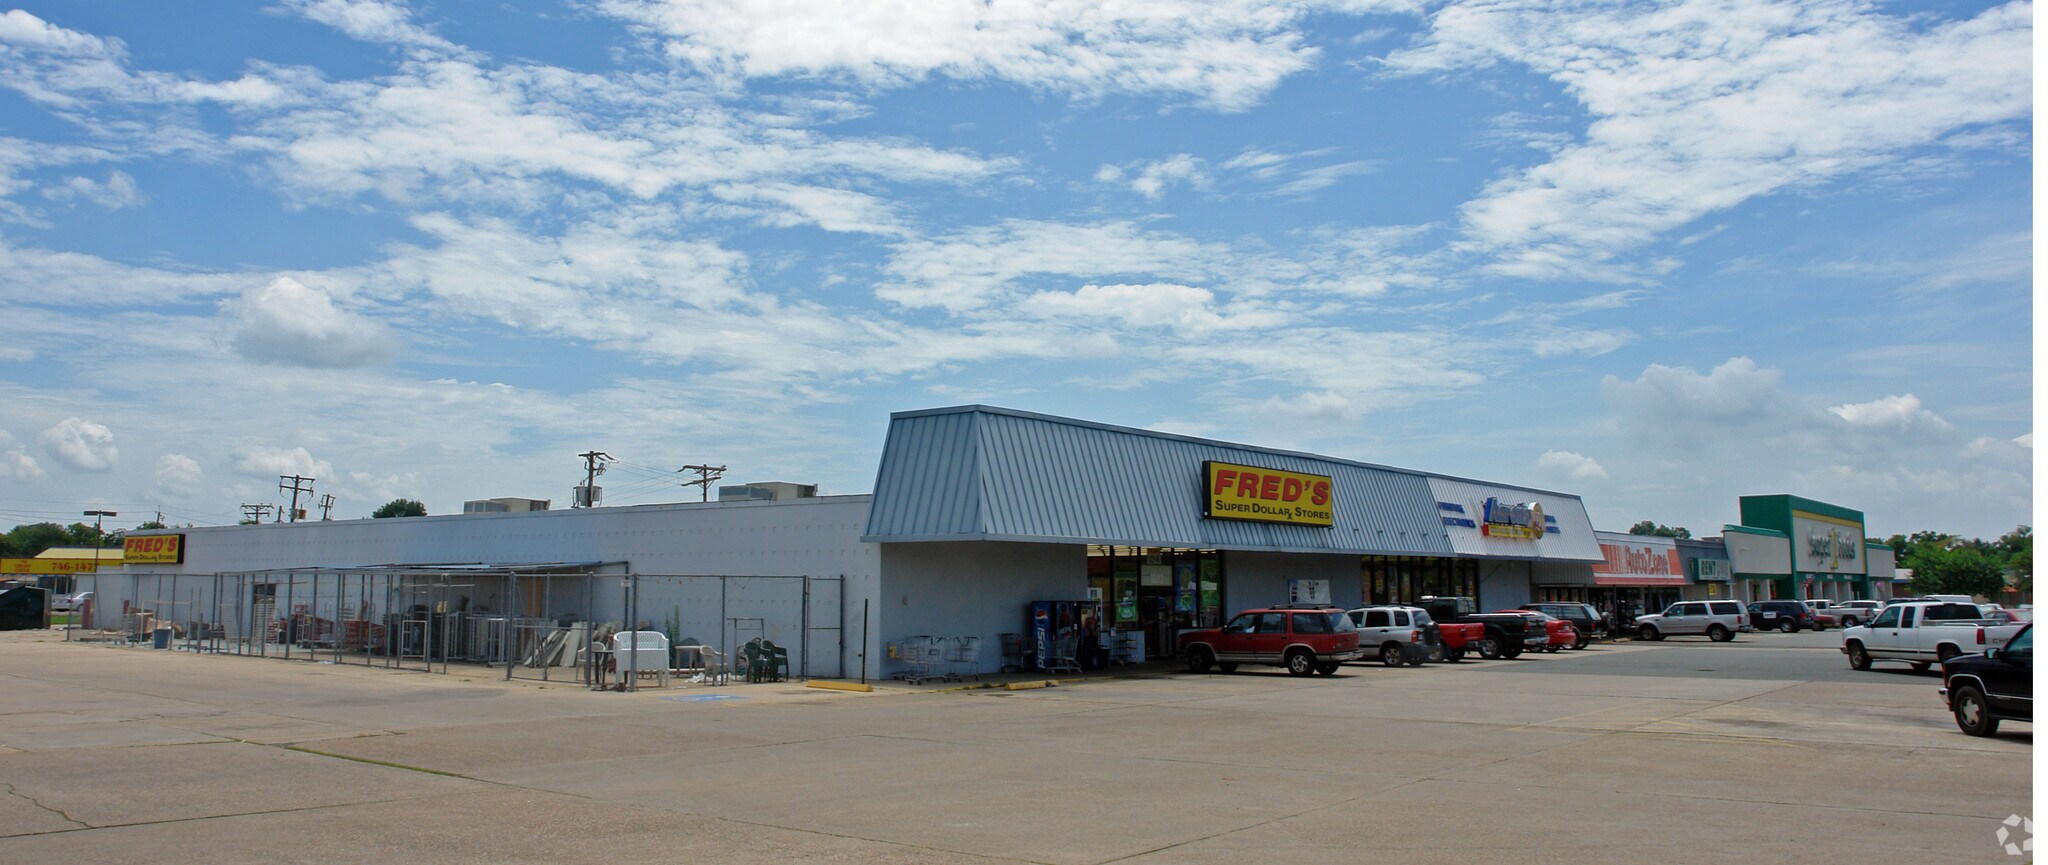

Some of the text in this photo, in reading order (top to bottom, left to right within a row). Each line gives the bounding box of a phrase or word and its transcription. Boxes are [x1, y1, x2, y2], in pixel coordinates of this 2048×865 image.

[1214, 470, 1329, 505] FRED'S
[1215, 500, 1250, 513] SUPER
[1295, 507, 1330, 519] STORES
[125, 537, 177, 552] FRED'S
[1623, 544, 1669, 575] AutoZone
[1701, 559, 1716, 576] RENT
[1037, 627, 1046, 669] PEPSI
